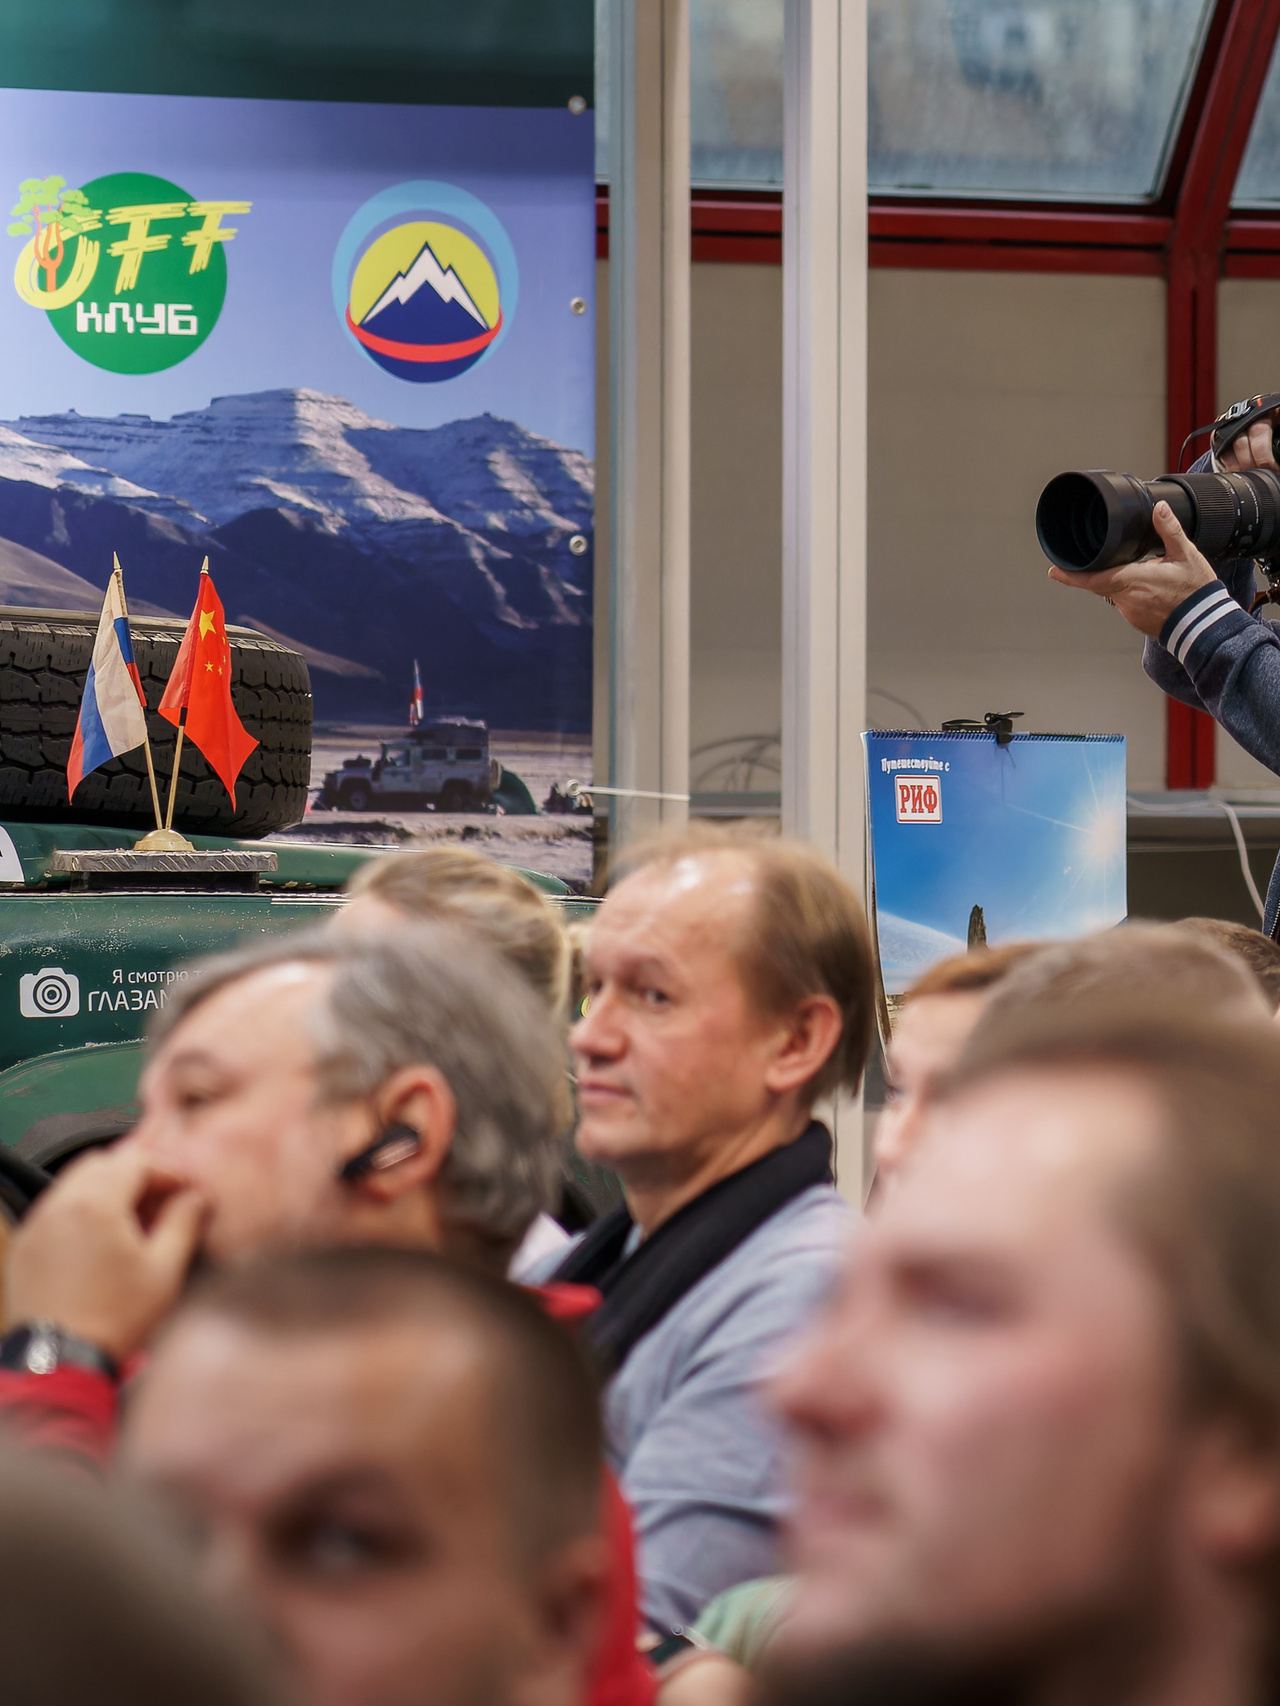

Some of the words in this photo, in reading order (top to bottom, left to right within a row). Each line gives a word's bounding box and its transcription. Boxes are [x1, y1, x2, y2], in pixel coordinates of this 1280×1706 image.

[14, 201, 253, 310] OFF
[76, 301, 198, 335] КЛУБ
[899, 785, 938, 813] РИФ
[112, 969, 123, 984] Я
[128, 969, 189, 986] смотрю
